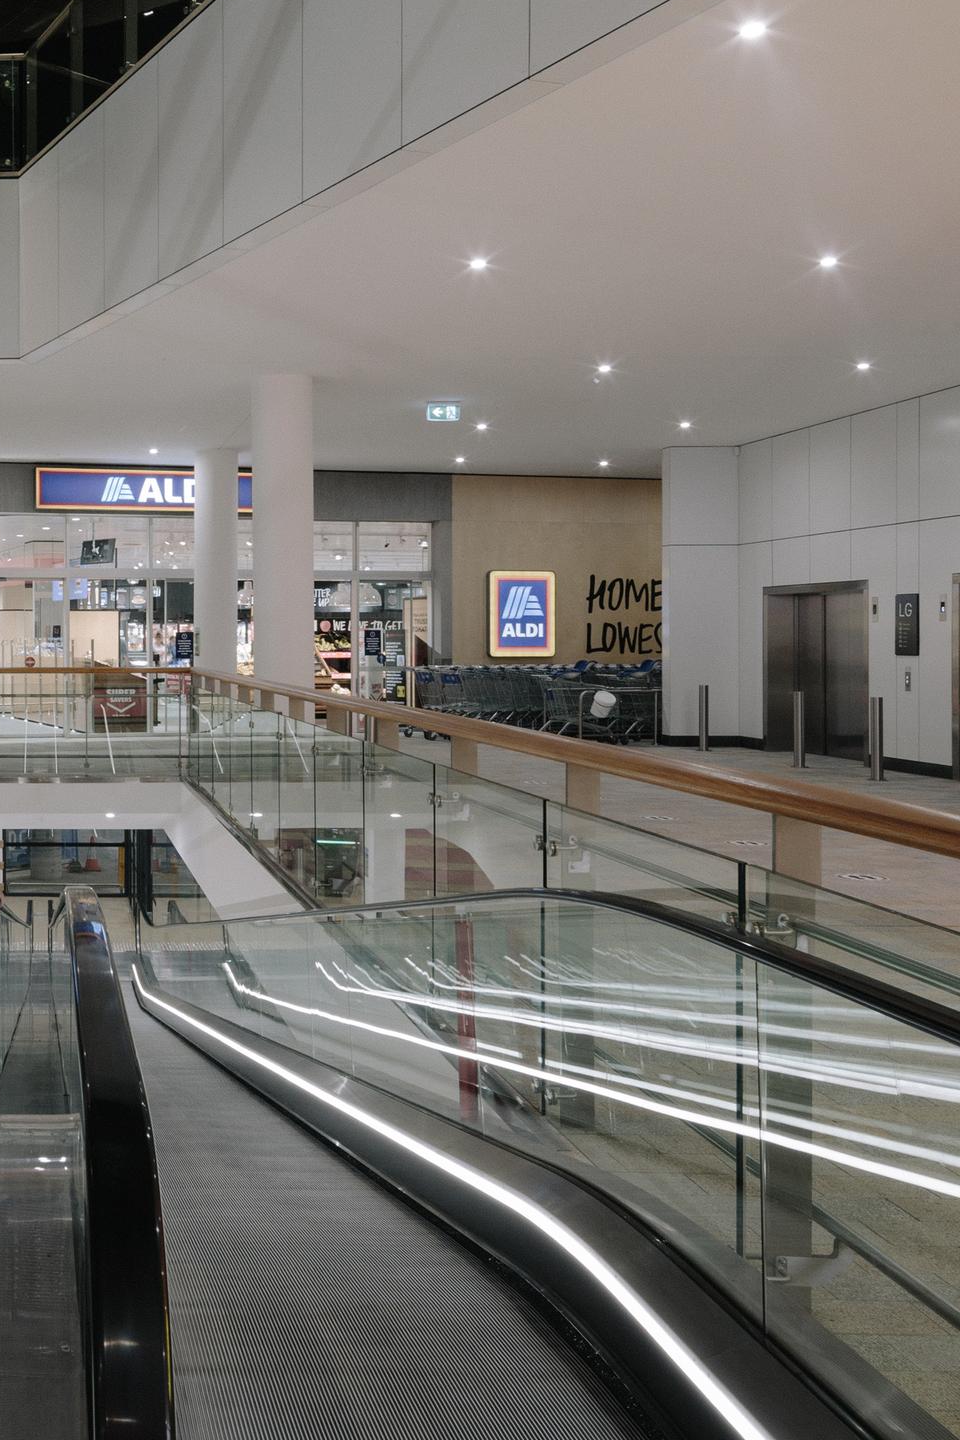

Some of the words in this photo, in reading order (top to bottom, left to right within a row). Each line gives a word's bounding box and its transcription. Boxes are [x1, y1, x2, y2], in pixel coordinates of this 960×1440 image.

[137, 477, 195, 503] ALD
[586, 574, 662, 613] HOME
[898, 602, 913, 617] LG
[333, 620, 346, 631] WE
[385, 620, 402, 631] GET
[502, 623, 544, 638] ALDI
[586, 621, 662, 655] LOWES
